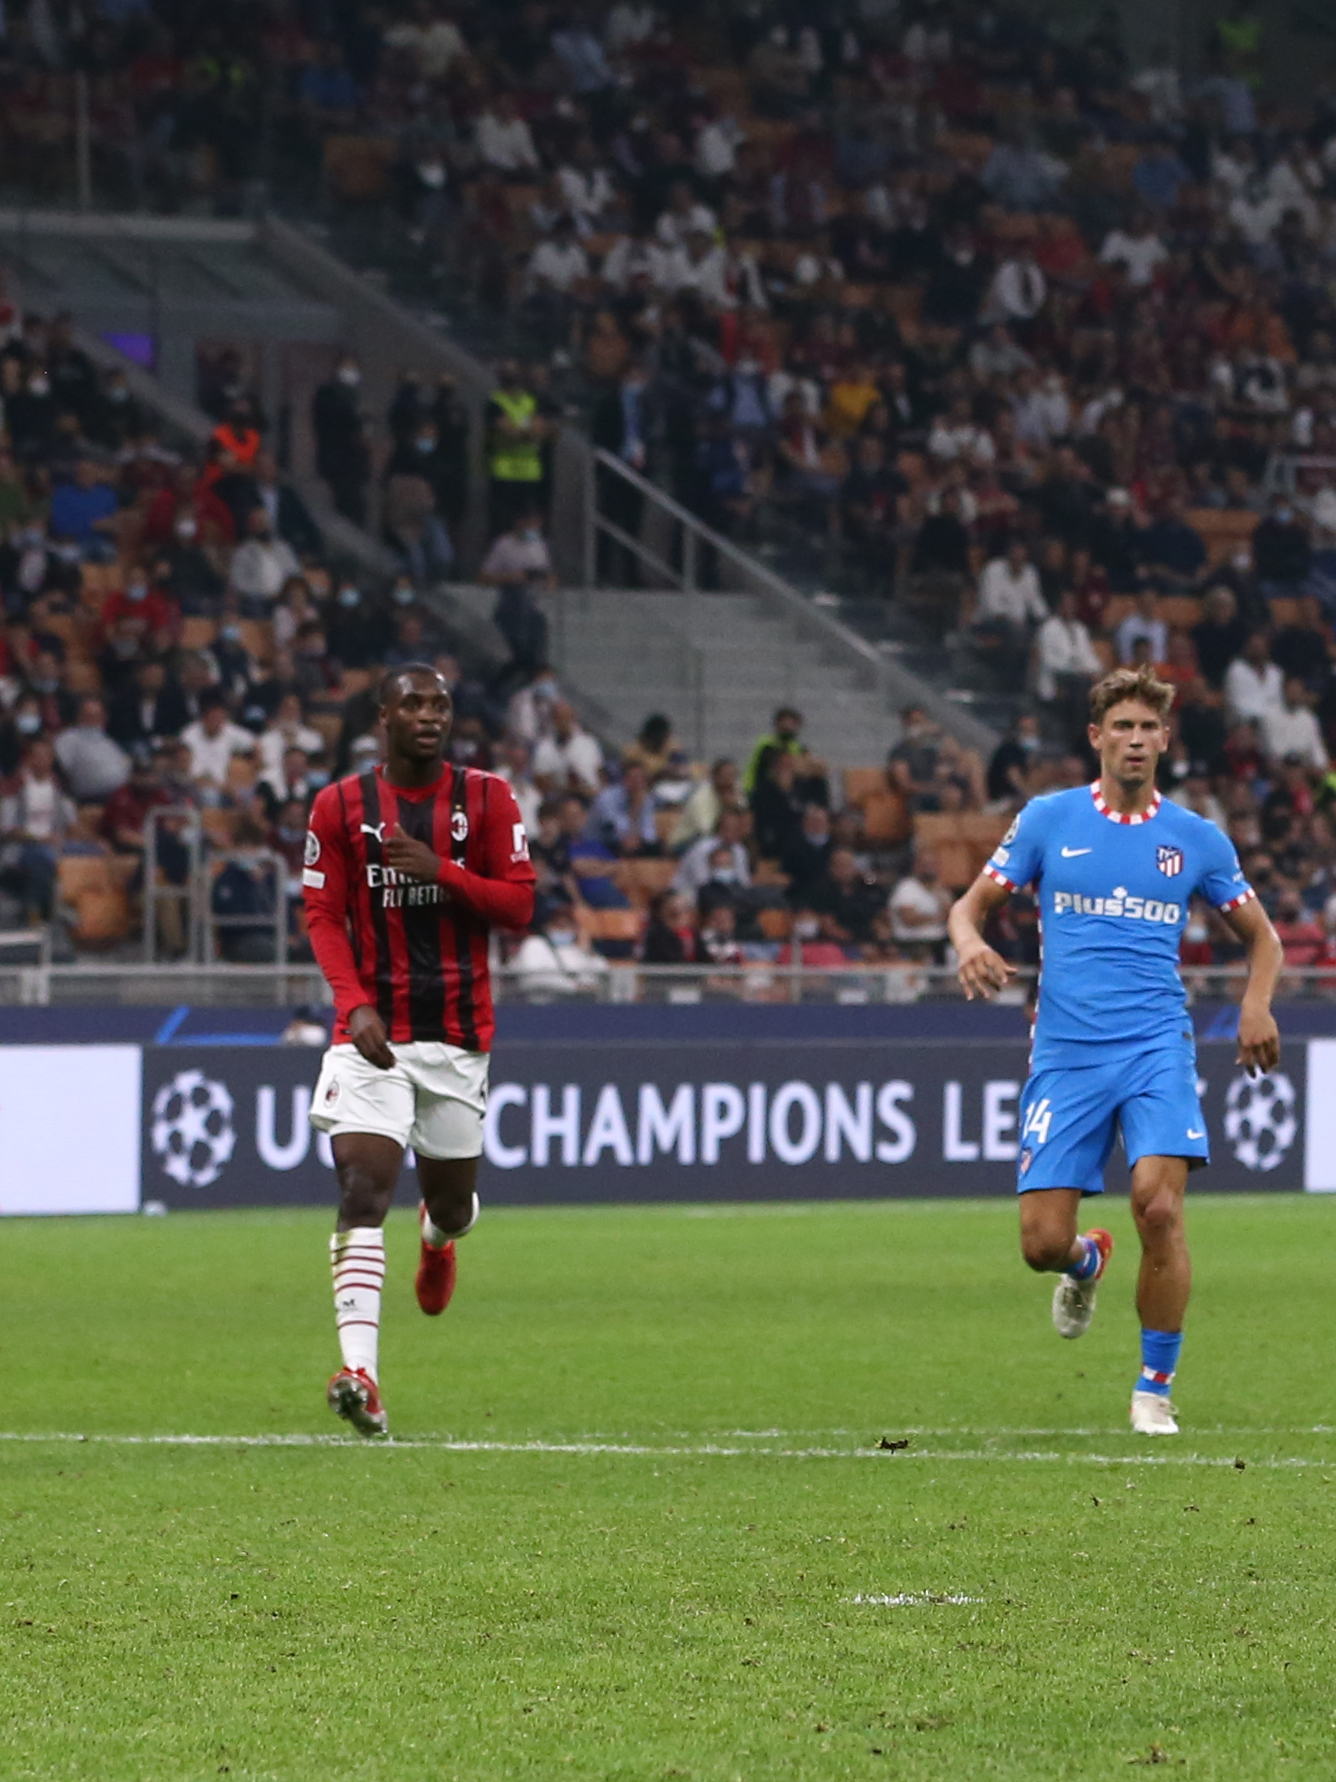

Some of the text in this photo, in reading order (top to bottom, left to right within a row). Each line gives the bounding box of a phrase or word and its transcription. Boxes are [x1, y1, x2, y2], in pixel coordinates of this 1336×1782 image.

[382, 887, 404, 908] FLY
[1054, 890, 1181, 925] Plus500
[482, 1080, 917, 1168] CHAMPIONS
[1022, 1099, 1052, 1144] 14
